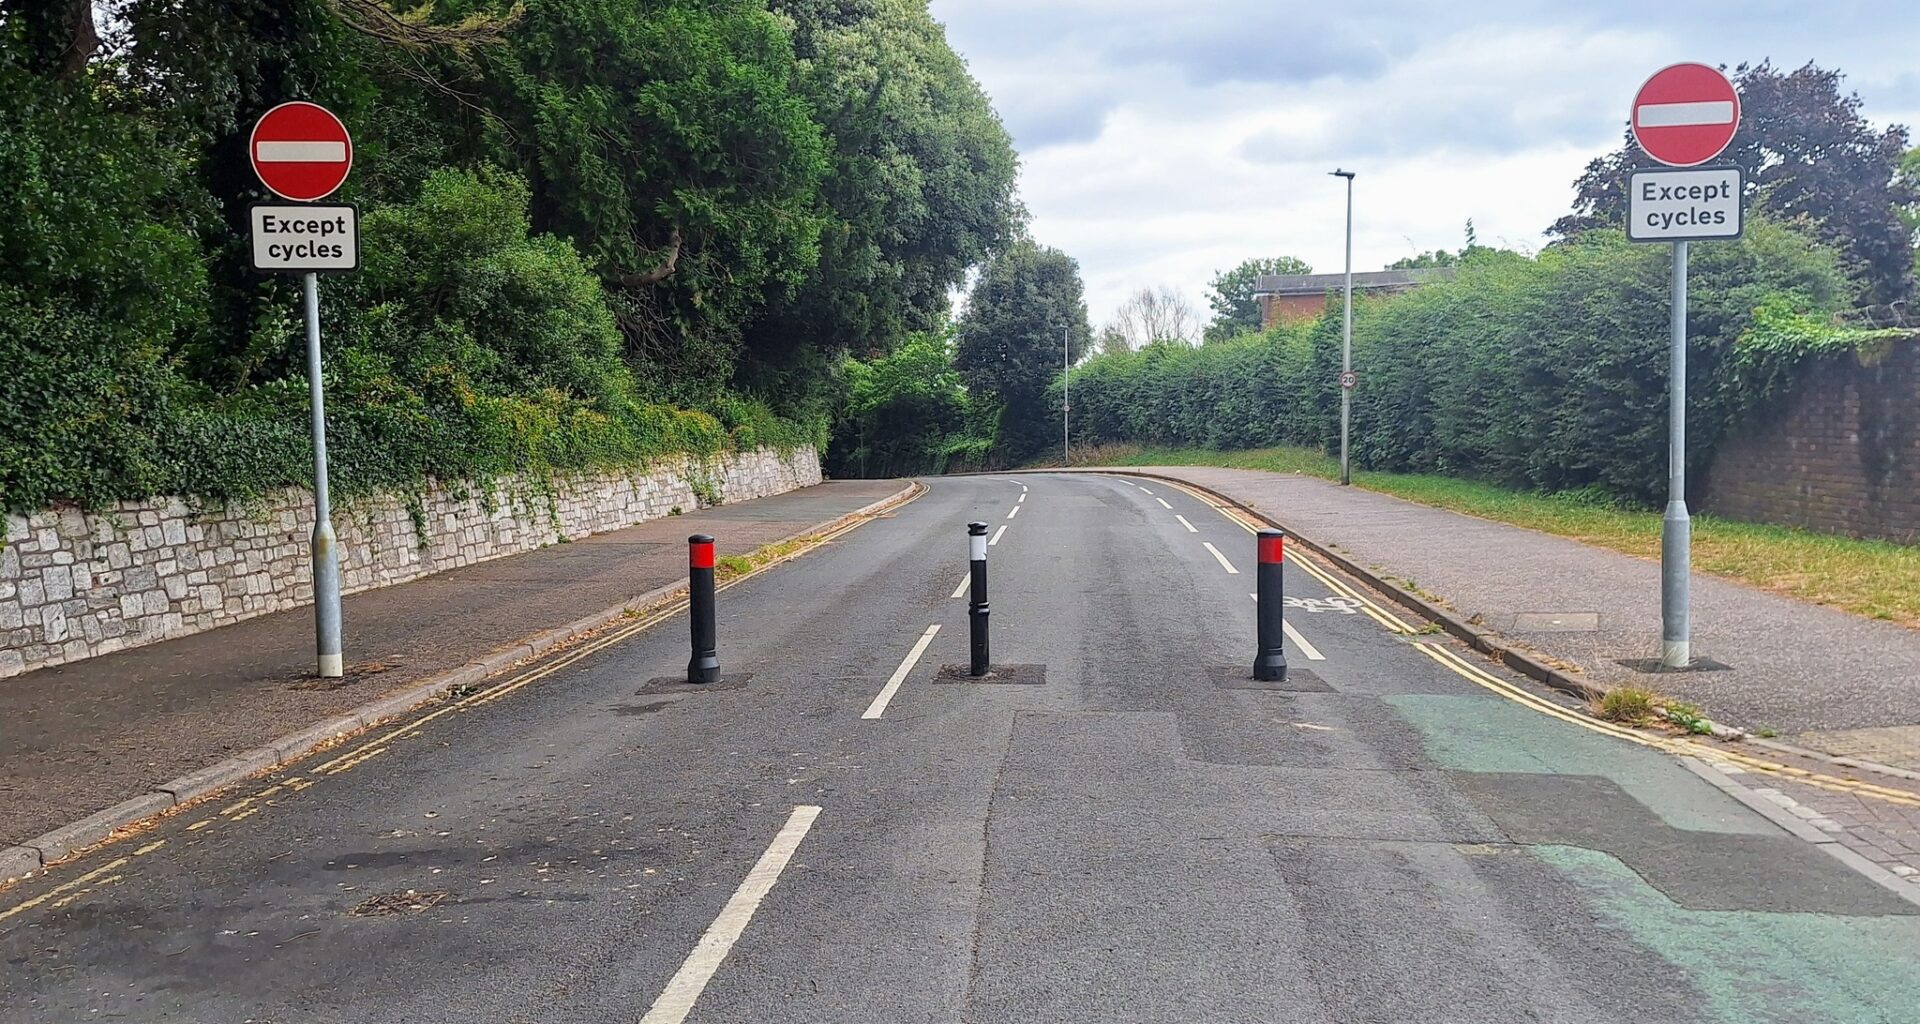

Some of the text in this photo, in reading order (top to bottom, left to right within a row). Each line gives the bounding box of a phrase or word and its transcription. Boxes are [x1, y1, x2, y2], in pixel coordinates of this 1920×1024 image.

[1642, 180, 1730, 203] Except
[262, 214, 346, 238] Except
[1646, 206, 1725, 230] cycles
[268, 239, 343, 262] cycles
[1343, 376, 1354, 384] 20
